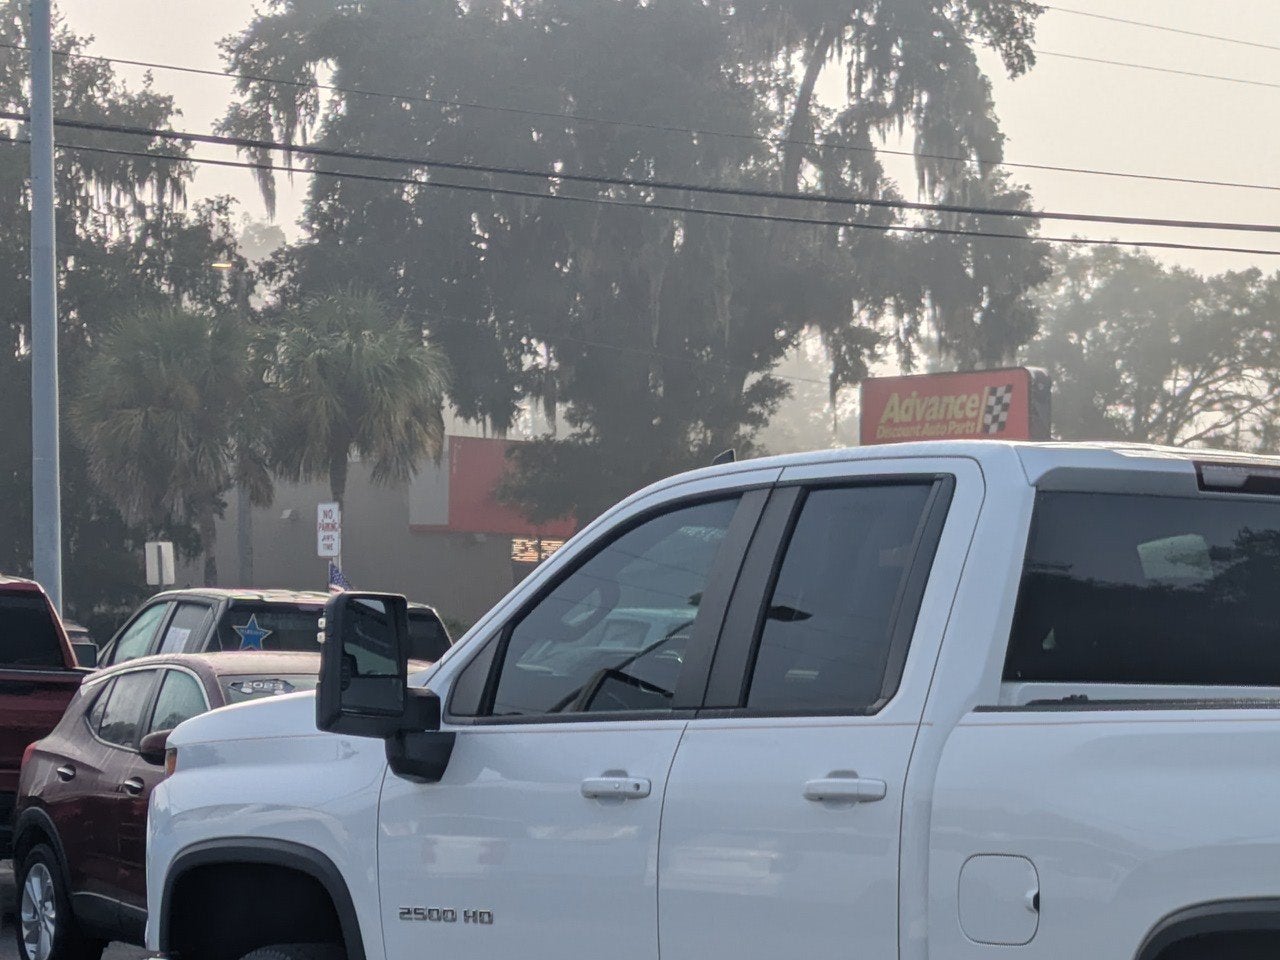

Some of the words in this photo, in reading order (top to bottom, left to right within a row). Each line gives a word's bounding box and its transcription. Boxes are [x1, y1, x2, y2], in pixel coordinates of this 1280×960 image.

[880, 391, 981, 424] Advance
[921, 421, 946, 437] Auto
[947, 420, 975, 435] Parts
[322, 509, 333, 519] NO
[399, 906, 457, 923] 2500
[463, 909, 494, 925] HD
